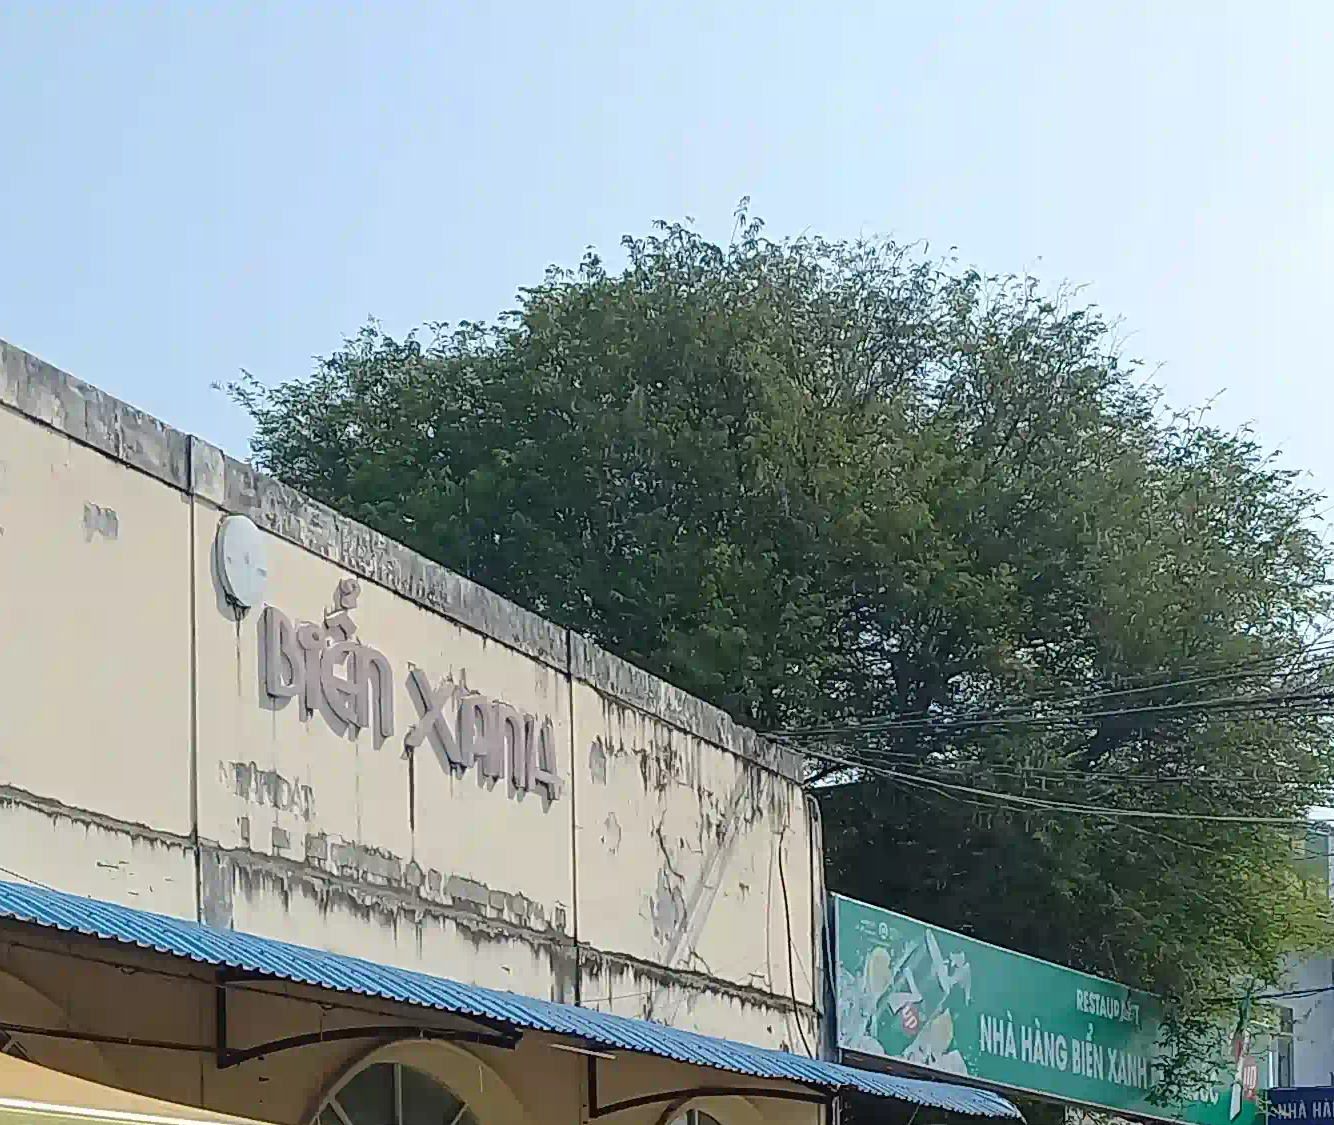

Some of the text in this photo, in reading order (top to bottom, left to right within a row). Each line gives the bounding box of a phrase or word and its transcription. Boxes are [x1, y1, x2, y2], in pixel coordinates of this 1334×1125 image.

[979, 1009, 1018, 1060] NHÀ
[1021, 1017, 1068, 1072] HÀNG
[1071, 1022, 1104, 1081] BIỂN
[1107, 1047, 1148, 1090] XANH
